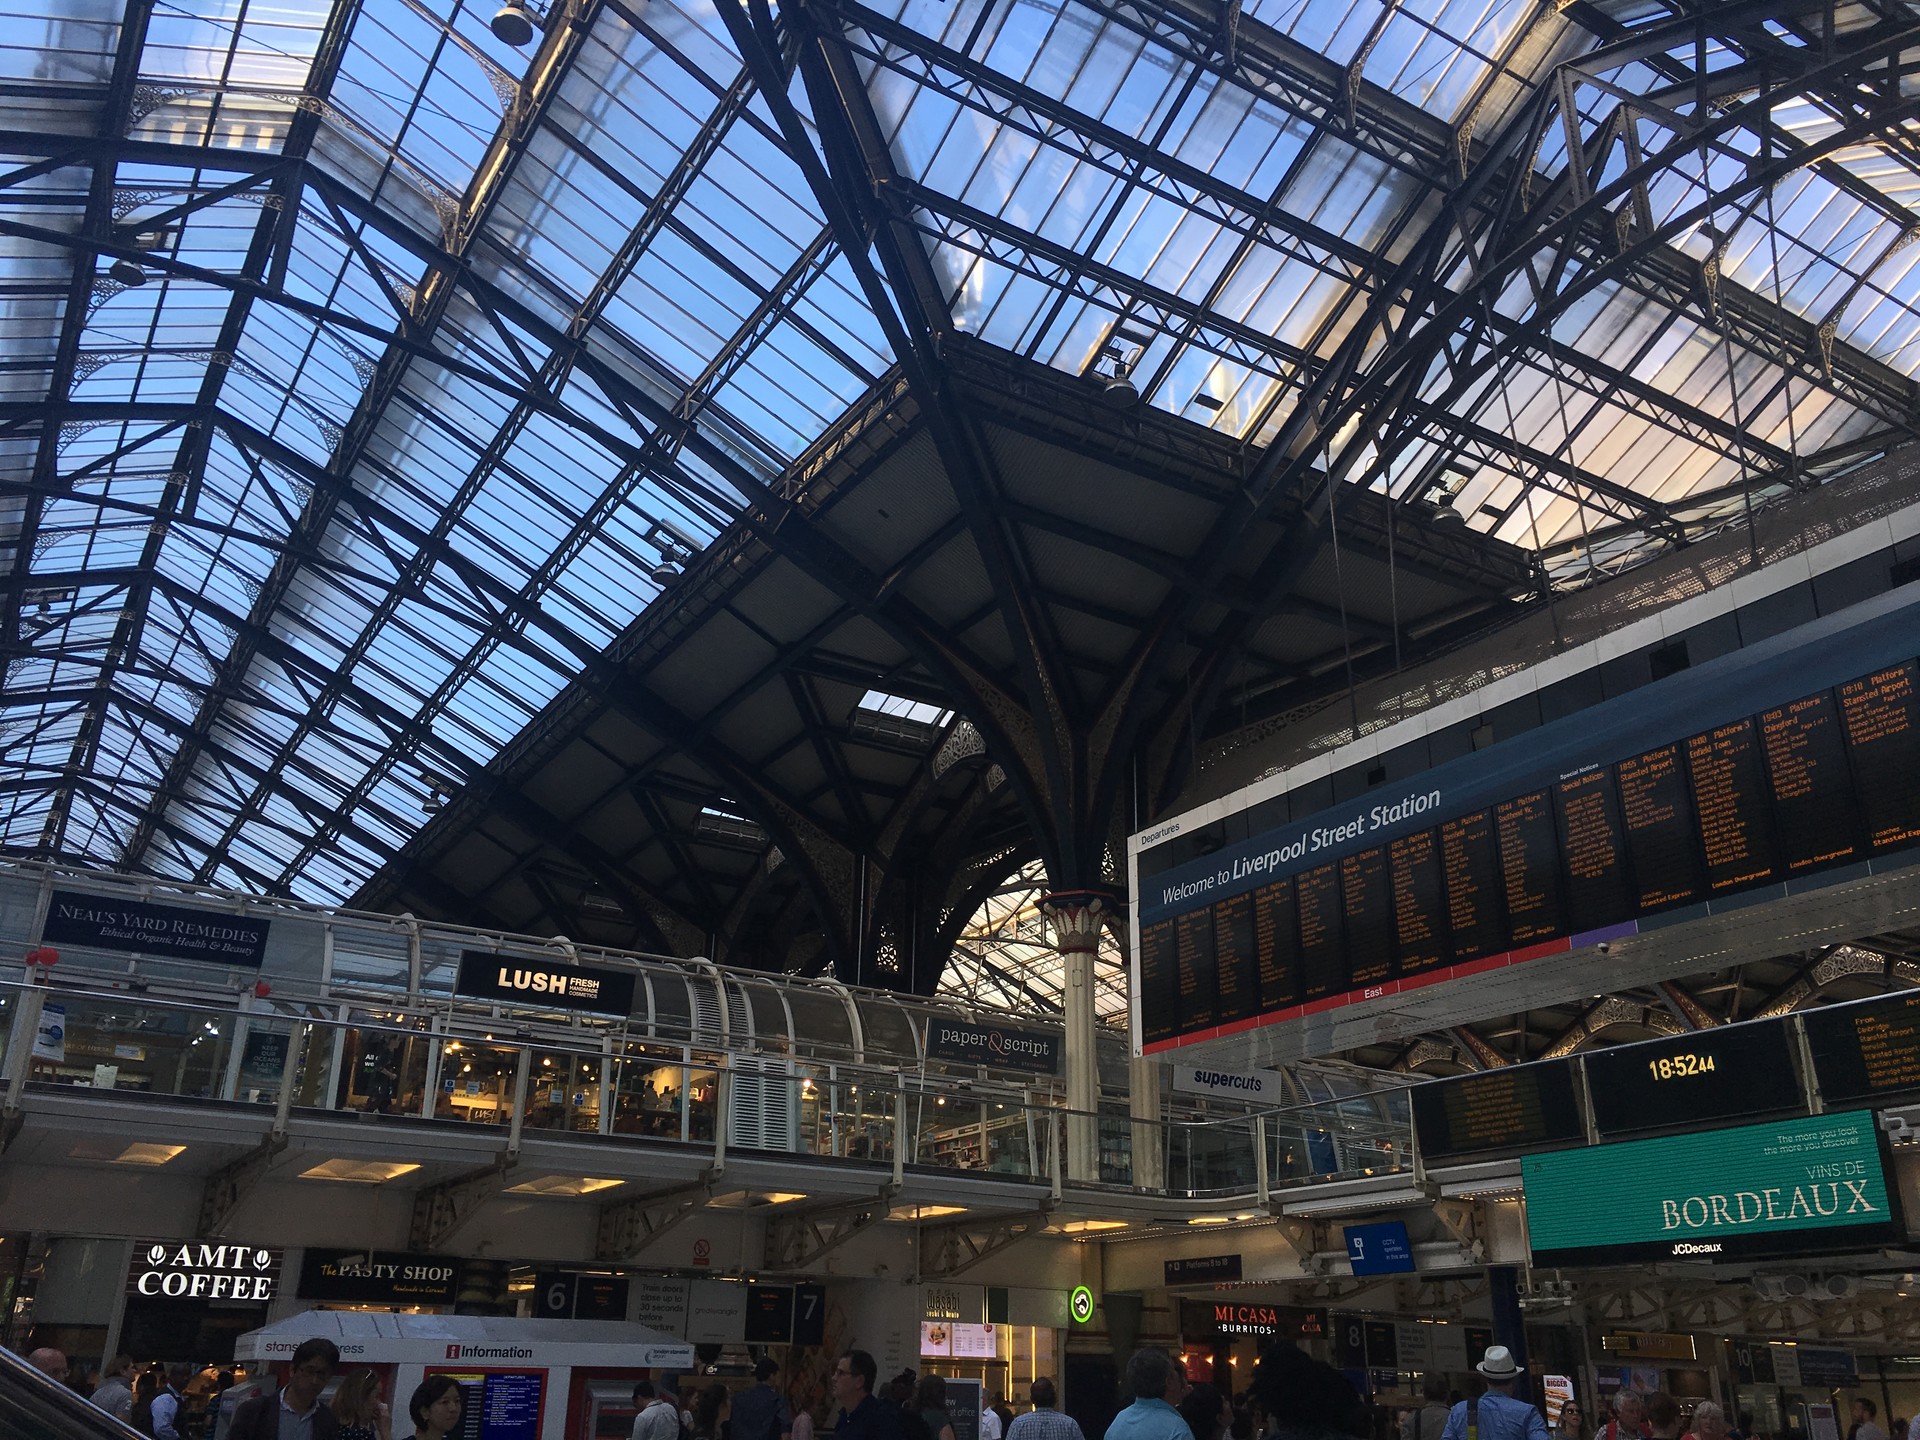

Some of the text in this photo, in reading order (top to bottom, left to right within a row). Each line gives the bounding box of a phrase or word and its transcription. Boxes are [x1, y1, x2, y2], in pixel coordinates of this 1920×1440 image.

[1870, 668, 1904, 684] Platform
[1843, 677, 1910, 706] Stansted Airport
[1789, 696, 1821, 713] Platform
[1713, 723, 1743, 738] Platform
[1714, 738, 1731, 750] Town
[1642, 748, 1669, 763] Platform
[1559, 762, 1598, 780] Special Notices
[1142, 822, 1180, 846] Departures
[1873, 832, 1906, 847] Stansted
[1163, 789, 1441, 905] Welcome to Liverpool Street Station
[1790, 846, 1852, 870] London Overground
[1712, 868, 1771, 889] London Overground
[122, 912, 167, 931] YARD
[172, 920, 258, 944] REMEDIES
[100, 926, 254, 956] Ethical Organic Health & Beauty
[498, 968, 600, 994] LUSH FRESH
[570, 985, 598, 994] HANDMADE
[568, 990, 598, 999] COSMETICS
[1364, 986, 1383, 998] East
[1194, 1070, 1262, 1091] supercuts
[1777, 1126, 1858, 1144] The more you look
[1764, 1136, 1860, 1156] the more you discover
[1805, 1160, 1866, 1179] VINS DE
[1661, 1179, 1880, 1230] BORDEAUX
[170, 1244, 250, 1269] AMT
[1672, 1242, 1722, 1256] JCDecaux
[320, 1264, 453, 1282] The PASTY SHOP
[138, 1272, 271, 1300] COFFEE
[642, 1283, 684, 1293] Train doors
[546, 1282, 566, 1310] 6
[640, 1294, 682, 1304] close up to
[927, 1292, 960, 1310] wasabi
[640, 1303, 684, 1313] 30 seconds
[802, 1295, 819, 1320] 7
[1214, 1305, 1278, 1324] MI CASA
[639, 1313, 663, 1322] before
[1302, 1323, 1321, 1333] CASA
[1348, 1324, 1361, 1348] 8
[461, 1345, 533, 1359] Information
[1736, 1348, 1750, 1367] 10
